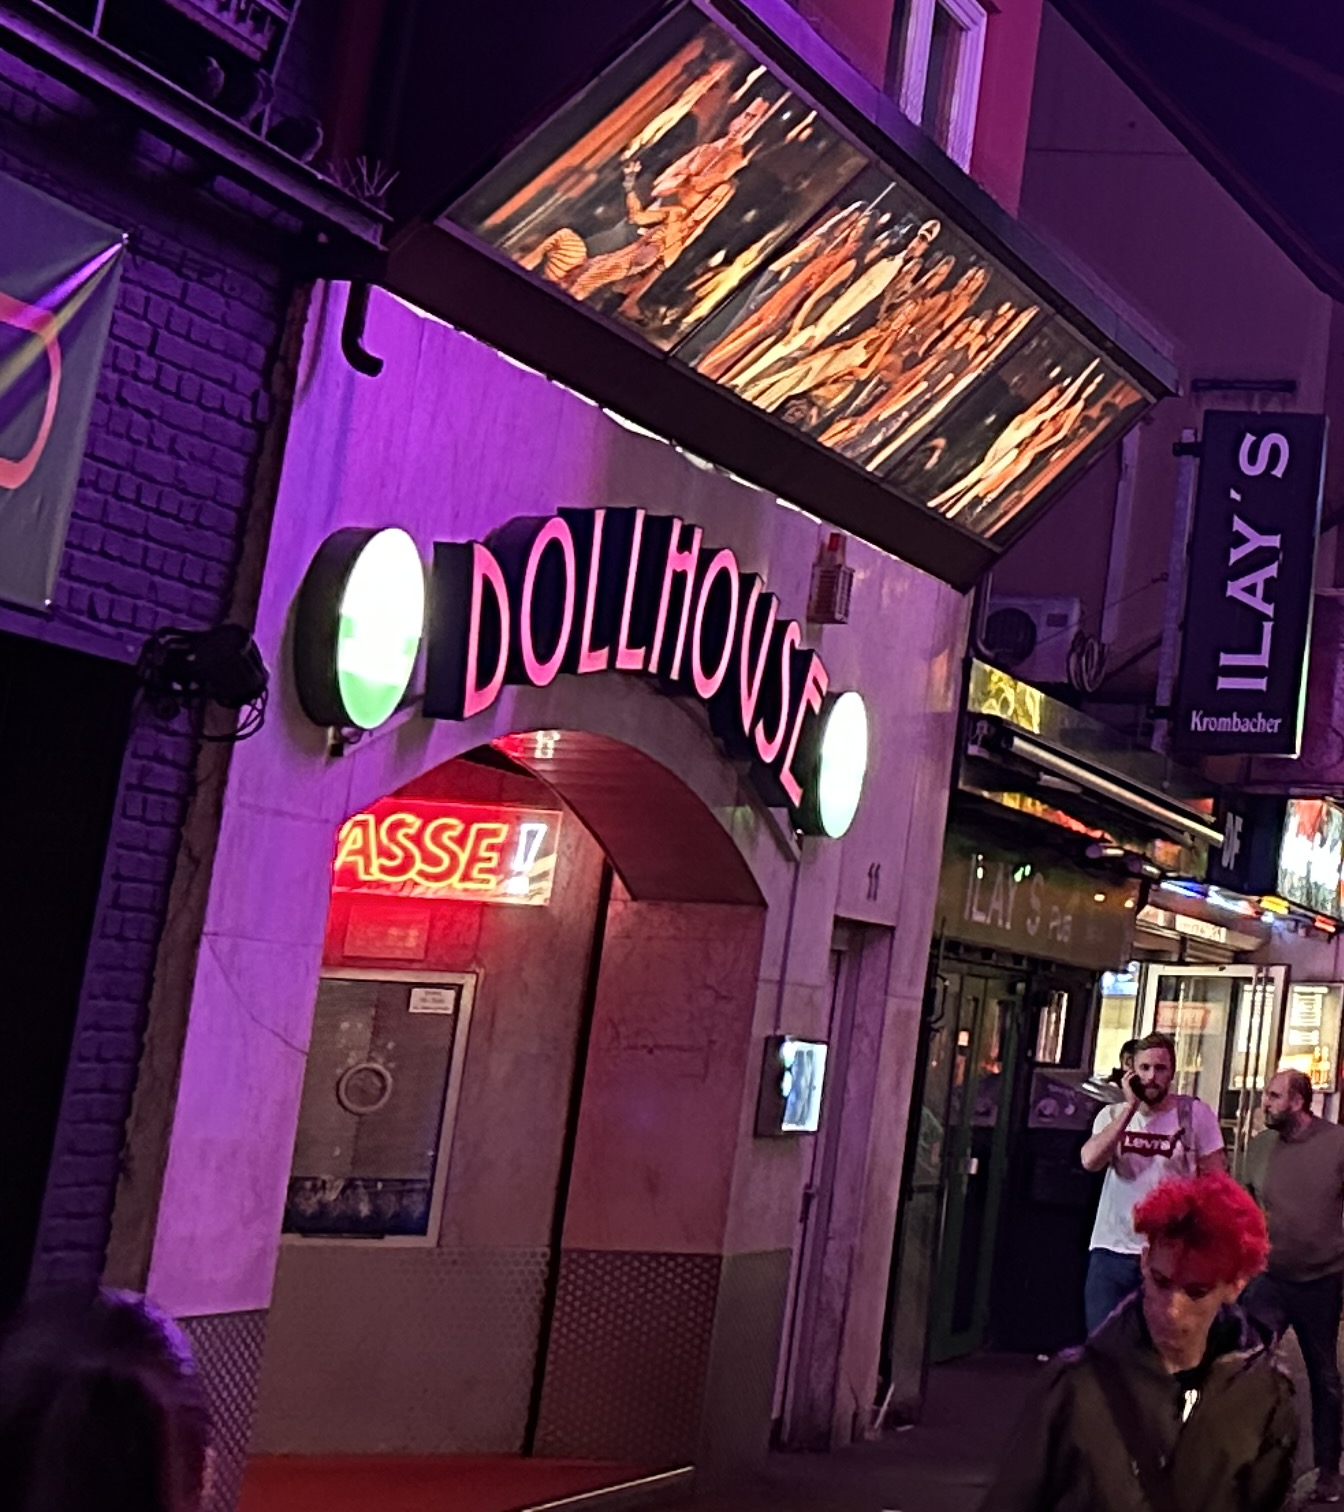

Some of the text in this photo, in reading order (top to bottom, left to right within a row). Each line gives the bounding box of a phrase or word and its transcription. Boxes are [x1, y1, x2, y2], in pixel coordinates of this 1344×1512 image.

[463, 507, 829, 808] DOLLHOUSE
[1216, 432, 1290, 692] ILAY'S
[1190, 709, 1283, 734] Krombacher
